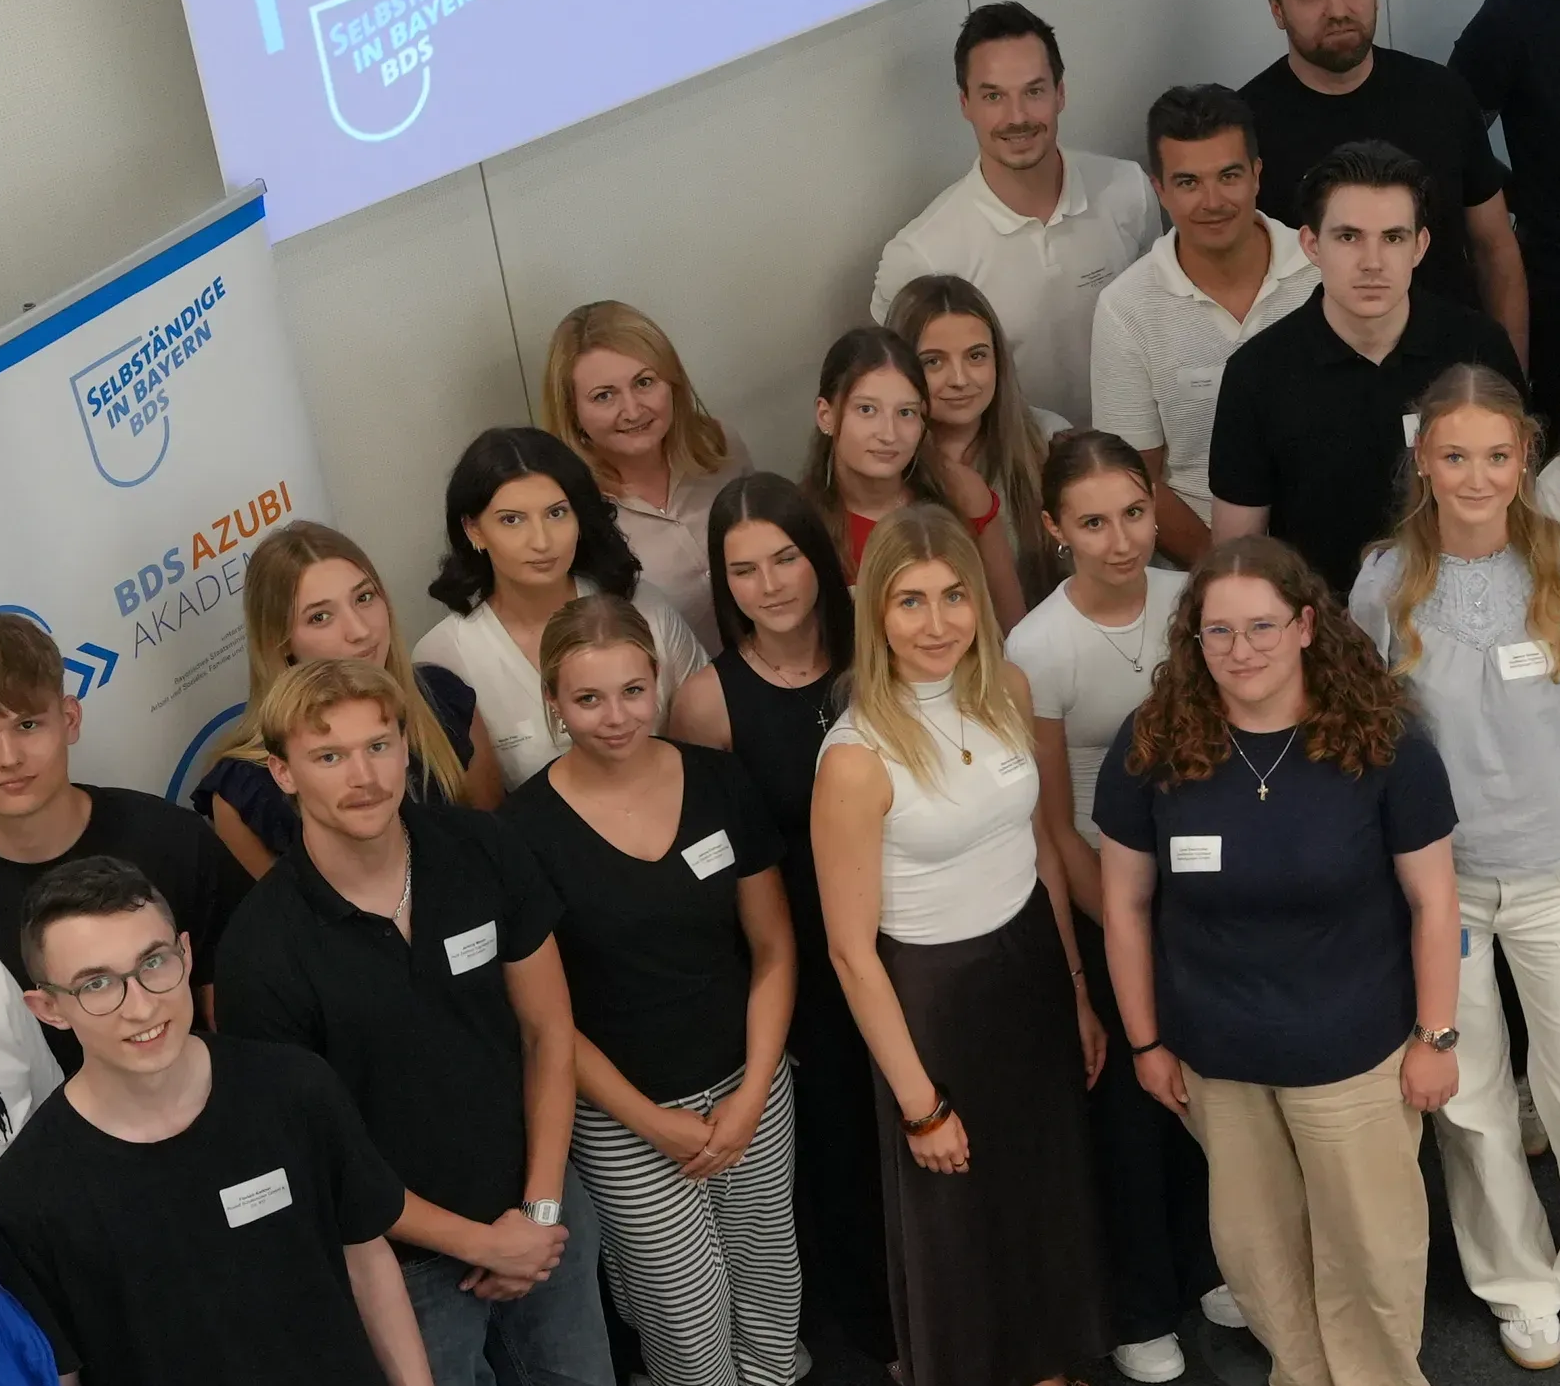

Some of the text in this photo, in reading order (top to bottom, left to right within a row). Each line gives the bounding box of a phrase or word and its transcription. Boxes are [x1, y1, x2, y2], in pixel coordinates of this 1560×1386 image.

[352, 36, 384, 74] IN
[380, 34, 434, 87] BDS
[86, 275, 227, 418] SELBSTÄNDIGE
[106, 319, 212, 430] IN BAYERN
[129, 388, 170, 438] BDS
[113, 480, 293, 618] BDS AZUBI
[209, 635, 245, 660] Staatsminis
